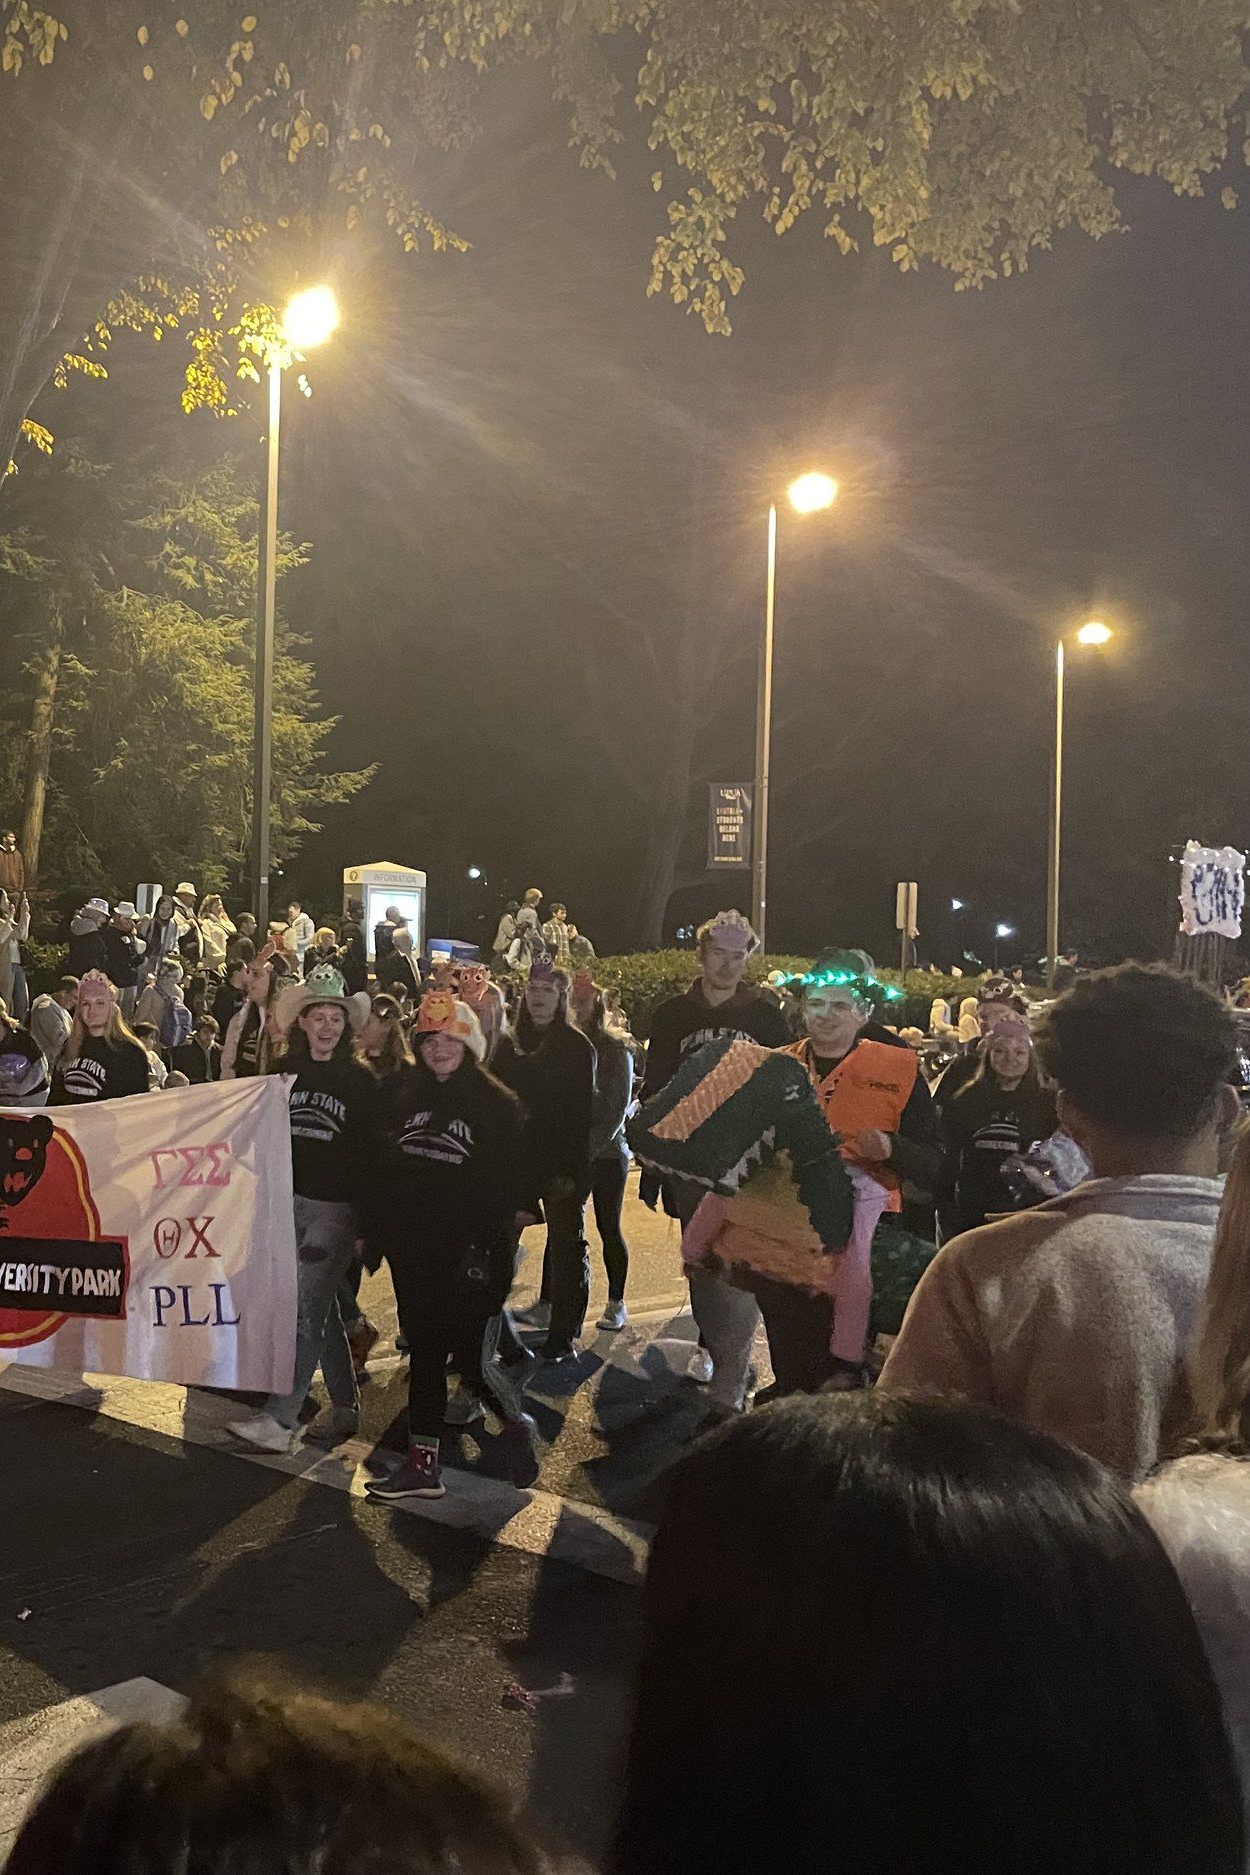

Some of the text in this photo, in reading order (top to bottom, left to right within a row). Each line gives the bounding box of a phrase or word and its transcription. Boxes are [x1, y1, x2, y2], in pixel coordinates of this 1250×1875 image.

[374, 872, 417, 884] INFORMATION
[311, 1092, 346, 1121] STATE
[71, 1268, 122, 1297] PARK
[149, 1283, 242, 1327] PLL
